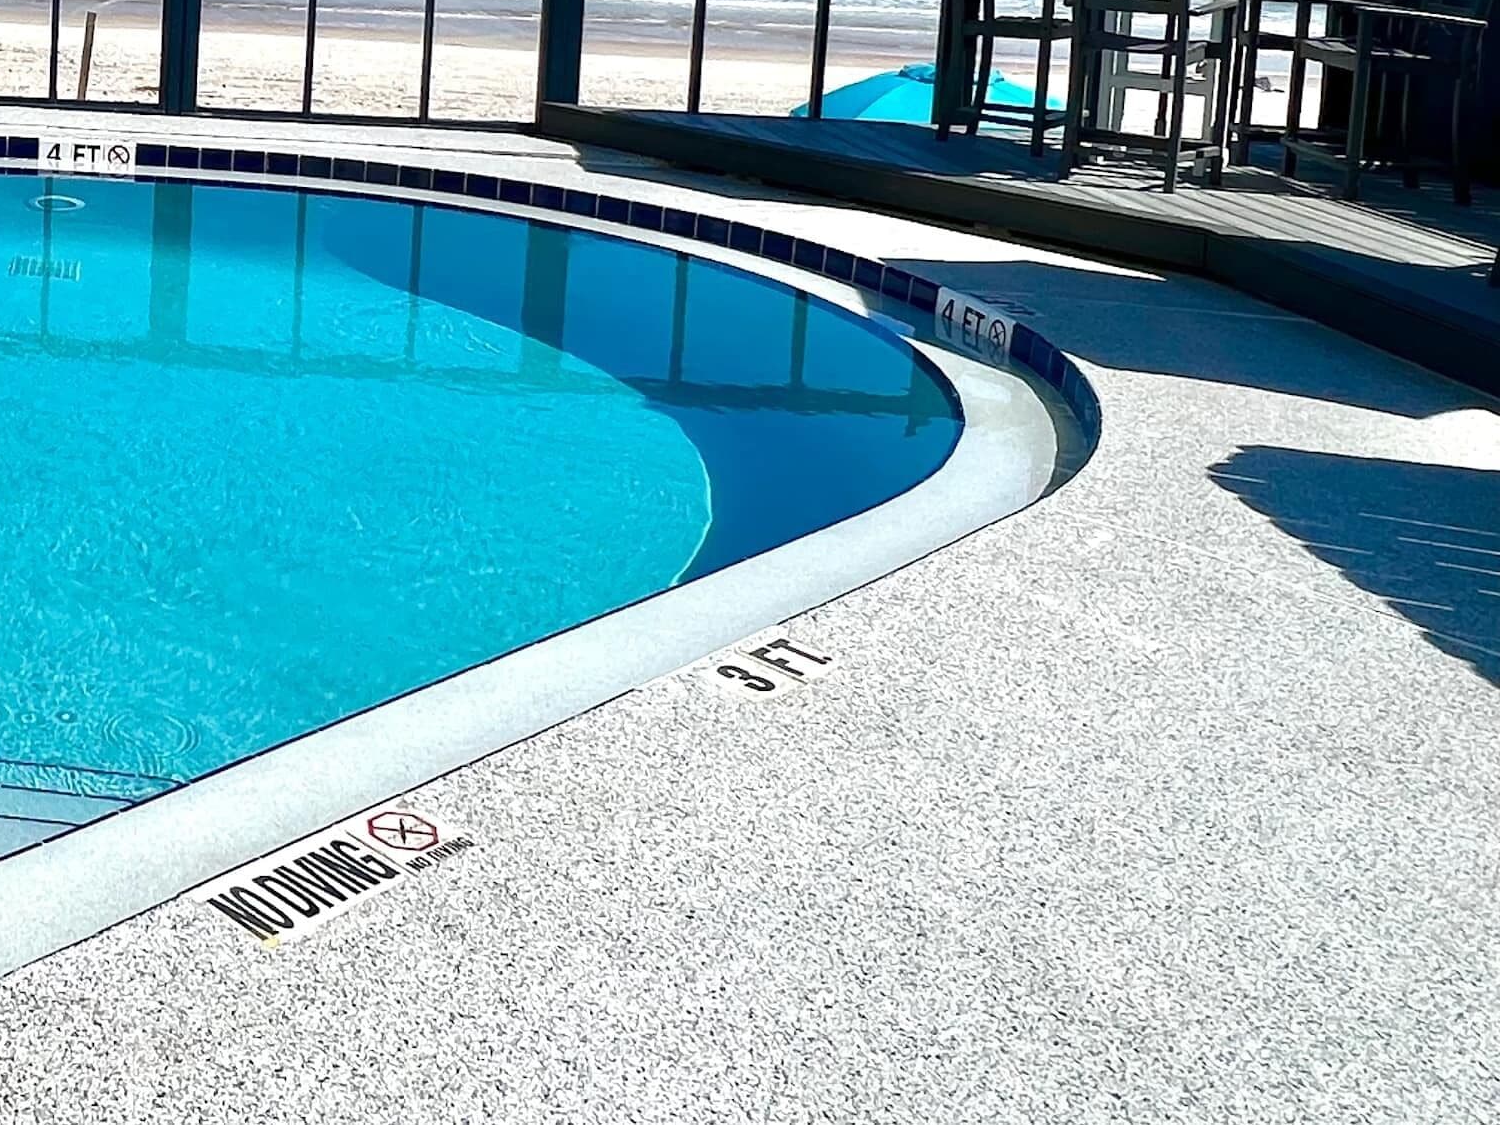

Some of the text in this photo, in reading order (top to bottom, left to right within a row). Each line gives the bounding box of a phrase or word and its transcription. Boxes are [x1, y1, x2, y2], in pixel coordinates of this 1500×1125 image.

[47, 143, 101, 163] 4 FT
[942, 299, 955, 321] 4
[962, 306, 986, 336] FT
[717, 665, 776, 691] 3
[405, 856, 432, 872] NO
[207, 839, 401, 941] NO DIVING
